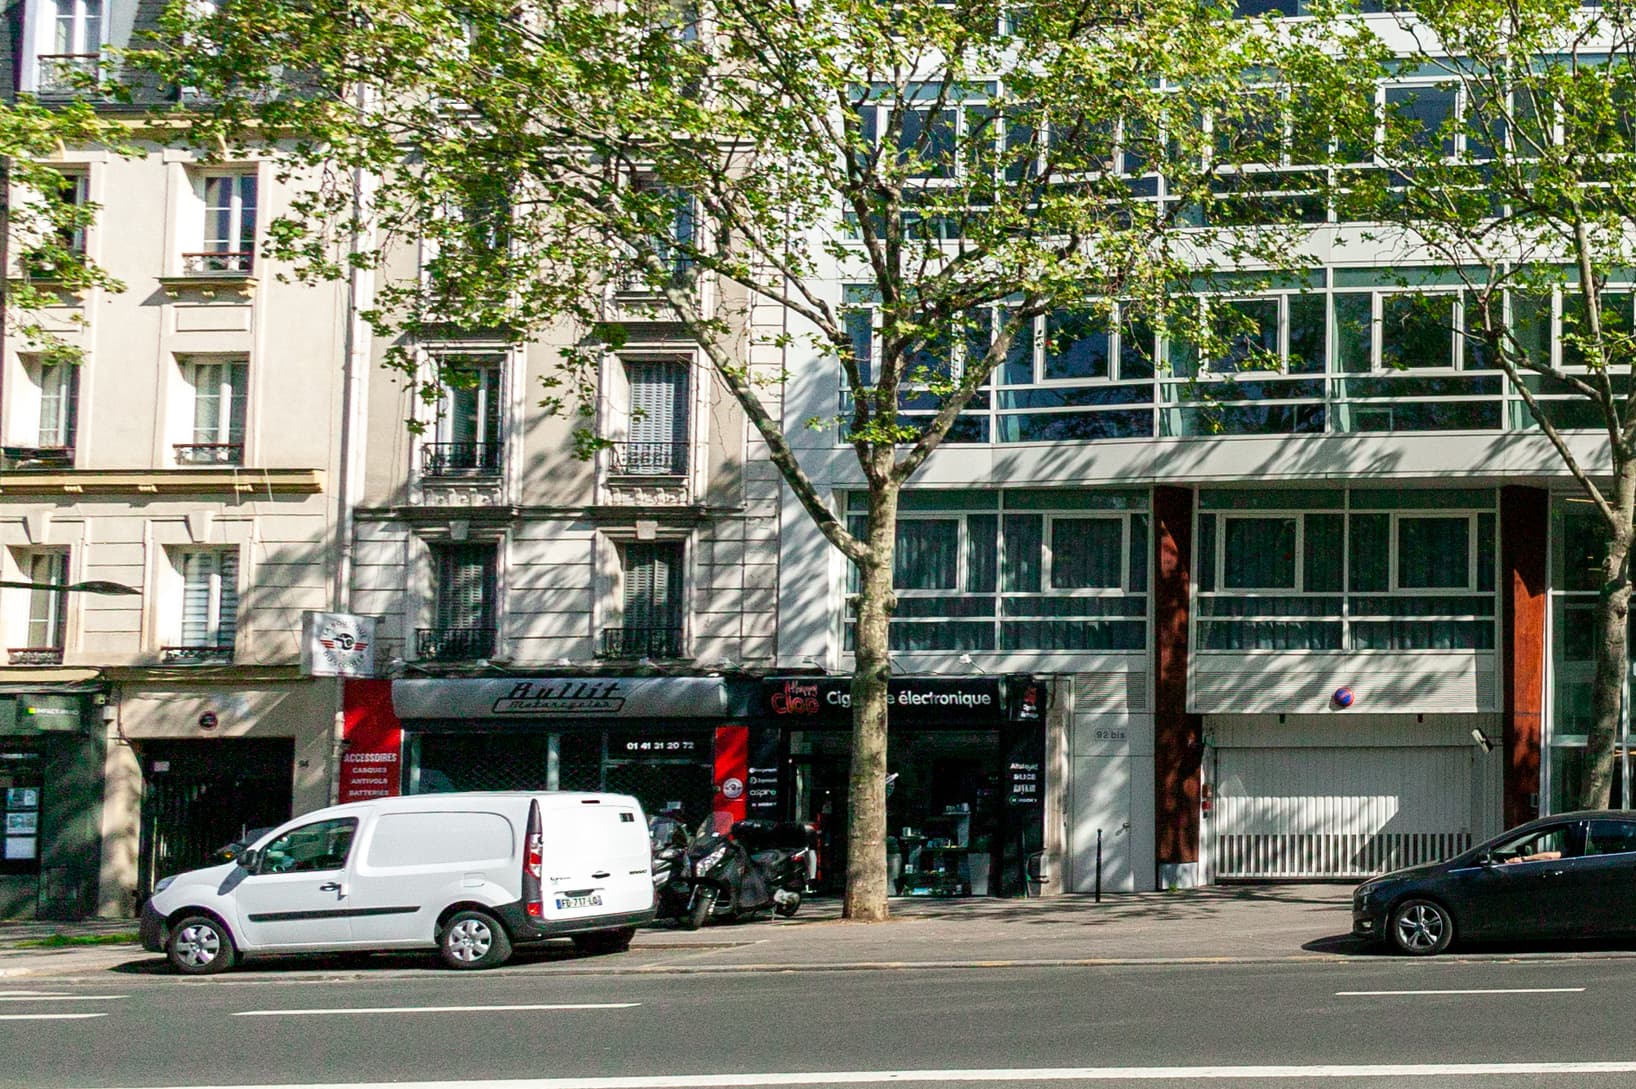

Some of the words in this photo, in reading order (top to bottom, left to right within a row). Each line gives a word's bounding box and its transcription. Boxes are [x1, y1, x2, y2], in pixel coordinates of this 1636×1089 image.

[898, 691, 991, 708] électronique
[1096, 731, 1108, 739] 92
[1111, 731, 1125, 739] bis
[627, 742, 638, 750] 01
[641, 742, 650, 750] 41
[666, 742, 680, 750] 20
[343, 753, 398, 763] ACCESSOIRES
